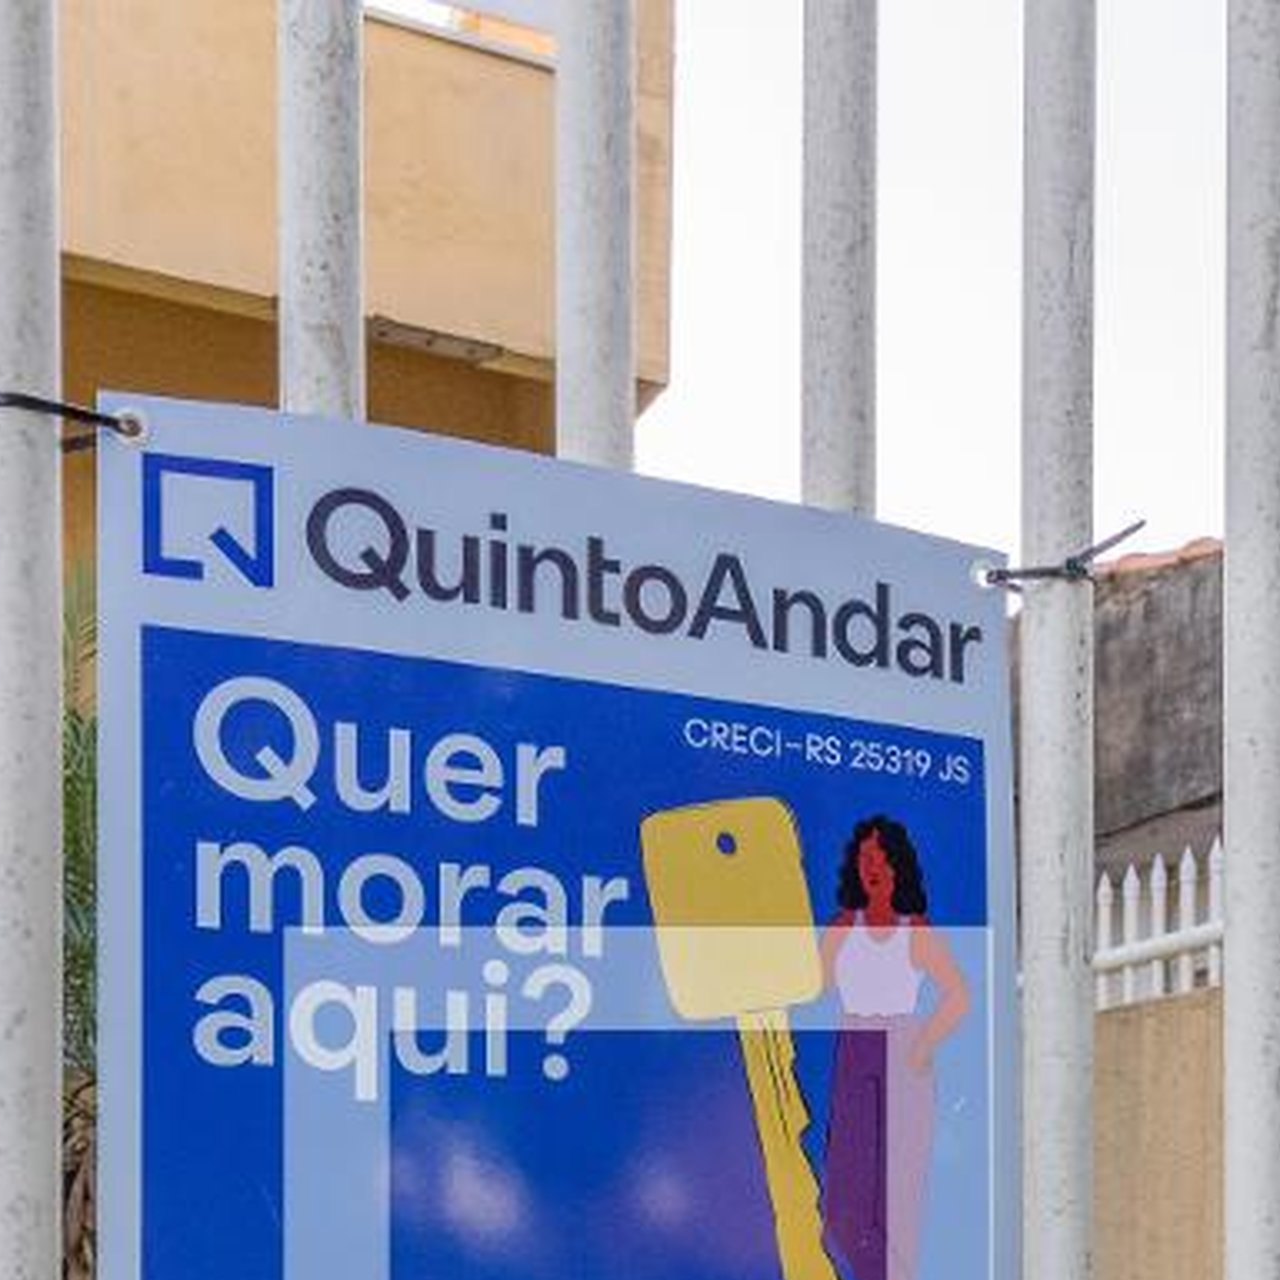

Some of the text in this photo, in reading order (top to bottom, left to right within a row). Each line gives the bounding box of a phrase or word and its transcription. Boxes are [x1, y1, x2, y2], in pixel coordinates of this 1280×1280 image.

[304, 486, 983, 686] QuintoAndar
[192, 675, 567, 827] Quer
[682, 717, 971, 785] CRECI-RS 25319 JS
[195, 840, 630, 958] morar
[192, 960, 594, 1102] aqui?
